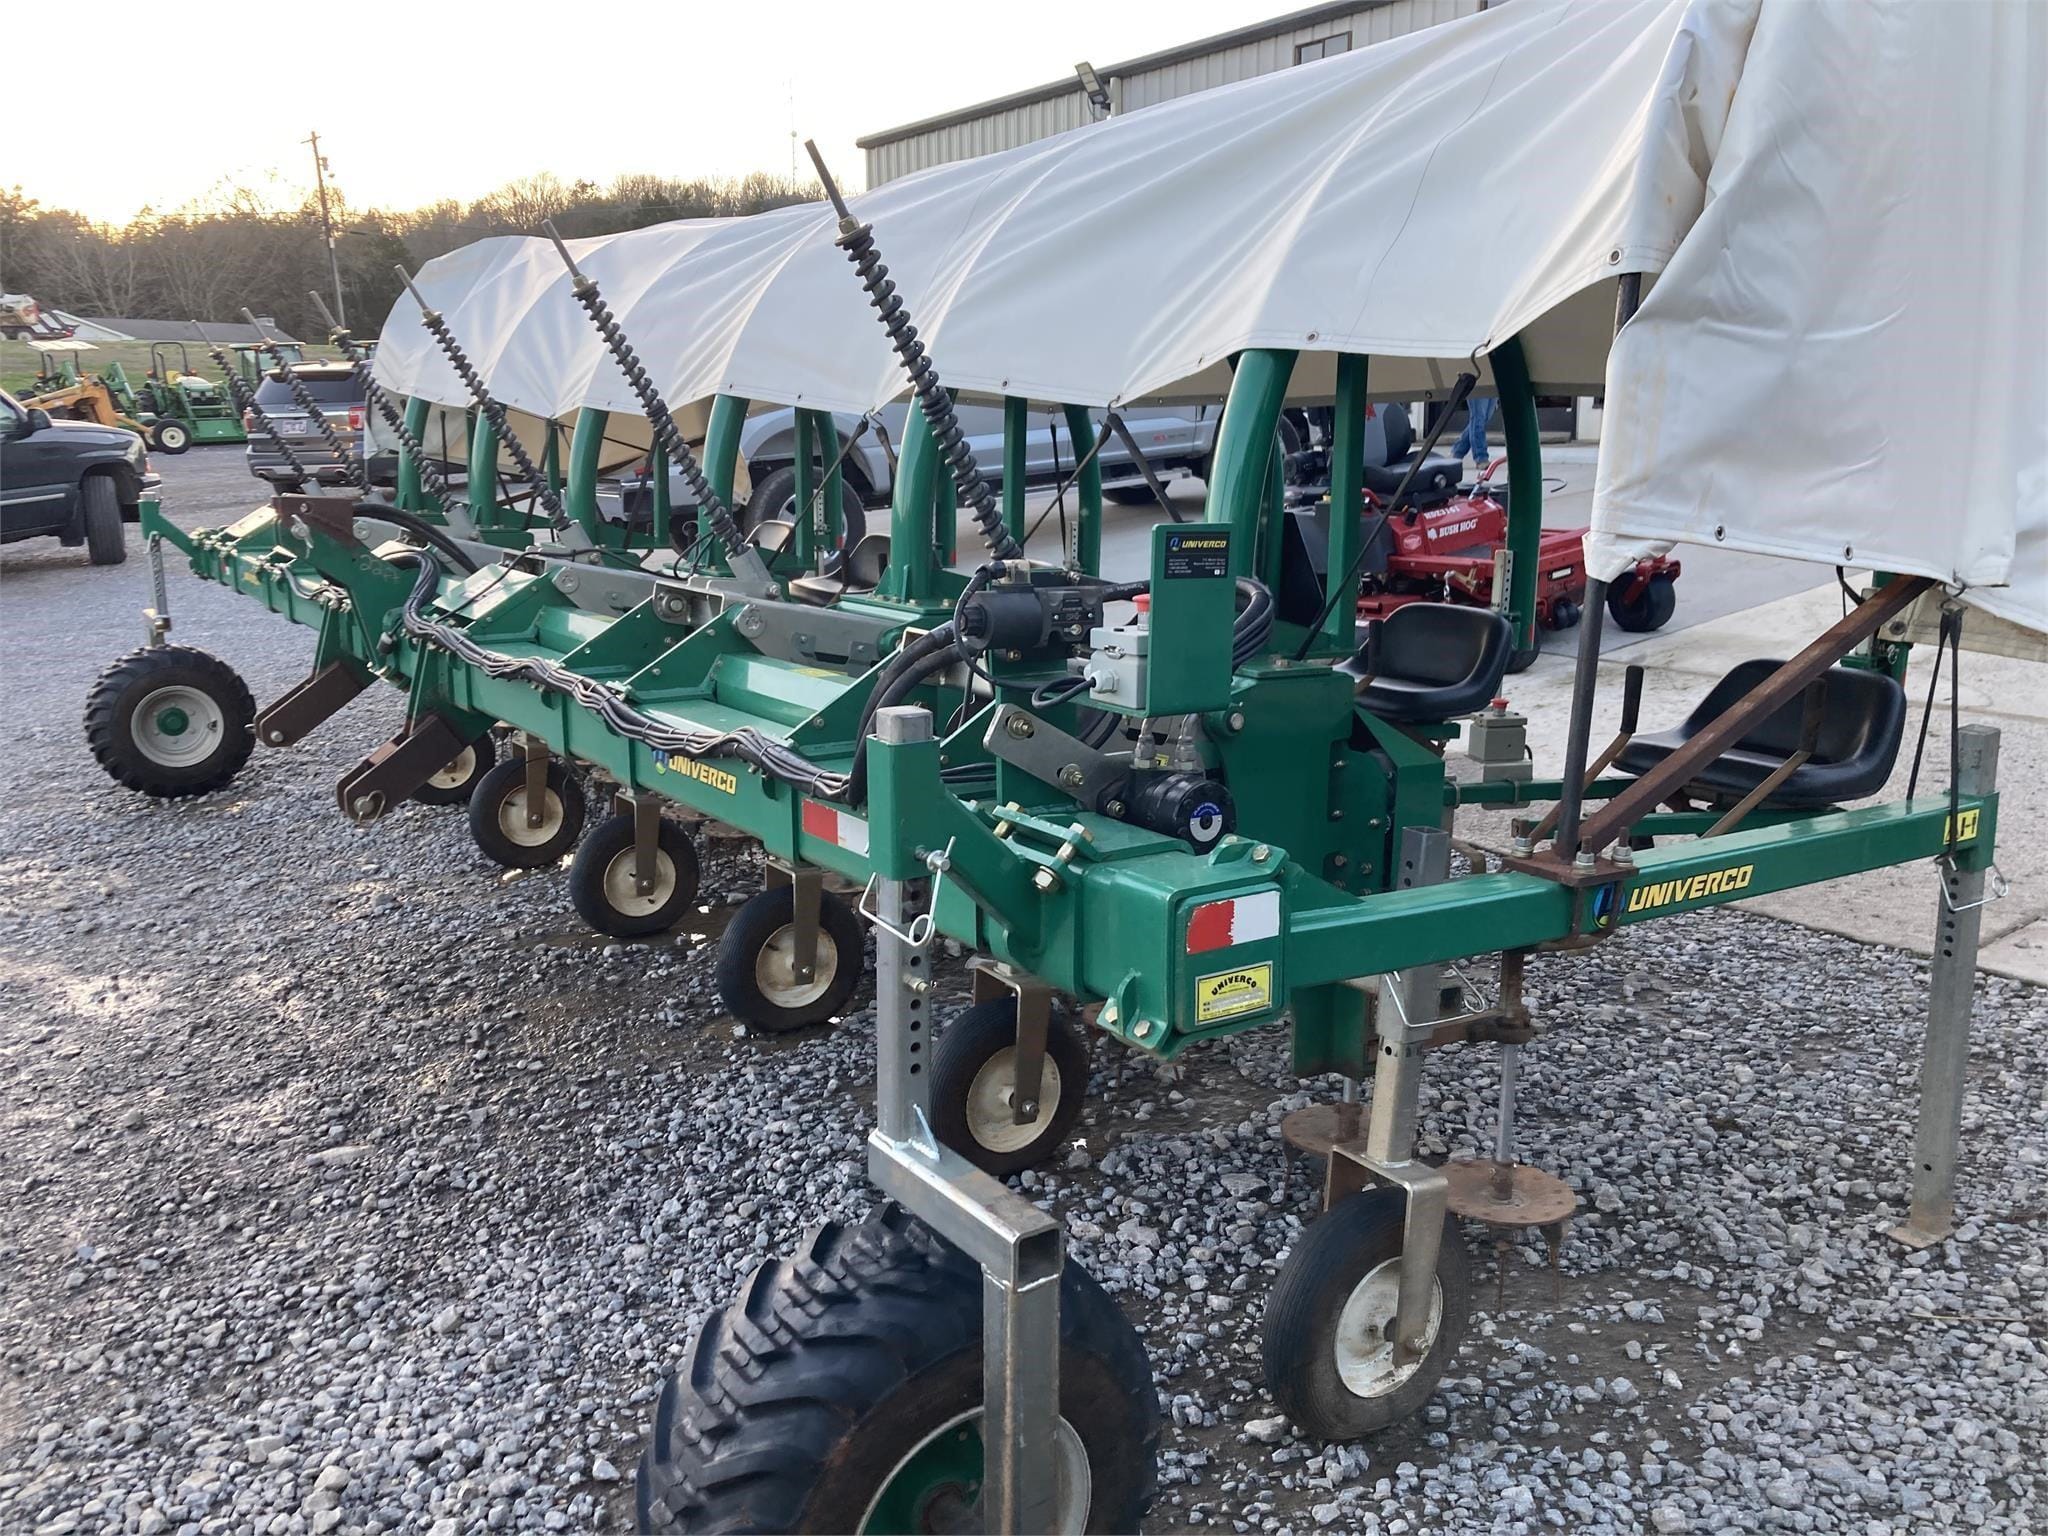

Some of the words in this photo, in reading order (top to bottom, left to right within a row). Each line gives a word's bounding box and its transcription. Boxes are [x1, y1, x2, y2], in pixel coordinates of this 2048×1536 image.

[1439, 523, 1459, 538] BUSH
[1460, 519, 1477, 533] HOG
[1181, 540, 1227, 549] UNIVERCO
[668, 755, 737, 795] UNIVERCO
[1628, 864, 1754, 912] UNIVERCO
[1211, 975, 1257, 996] UNIVERCO
